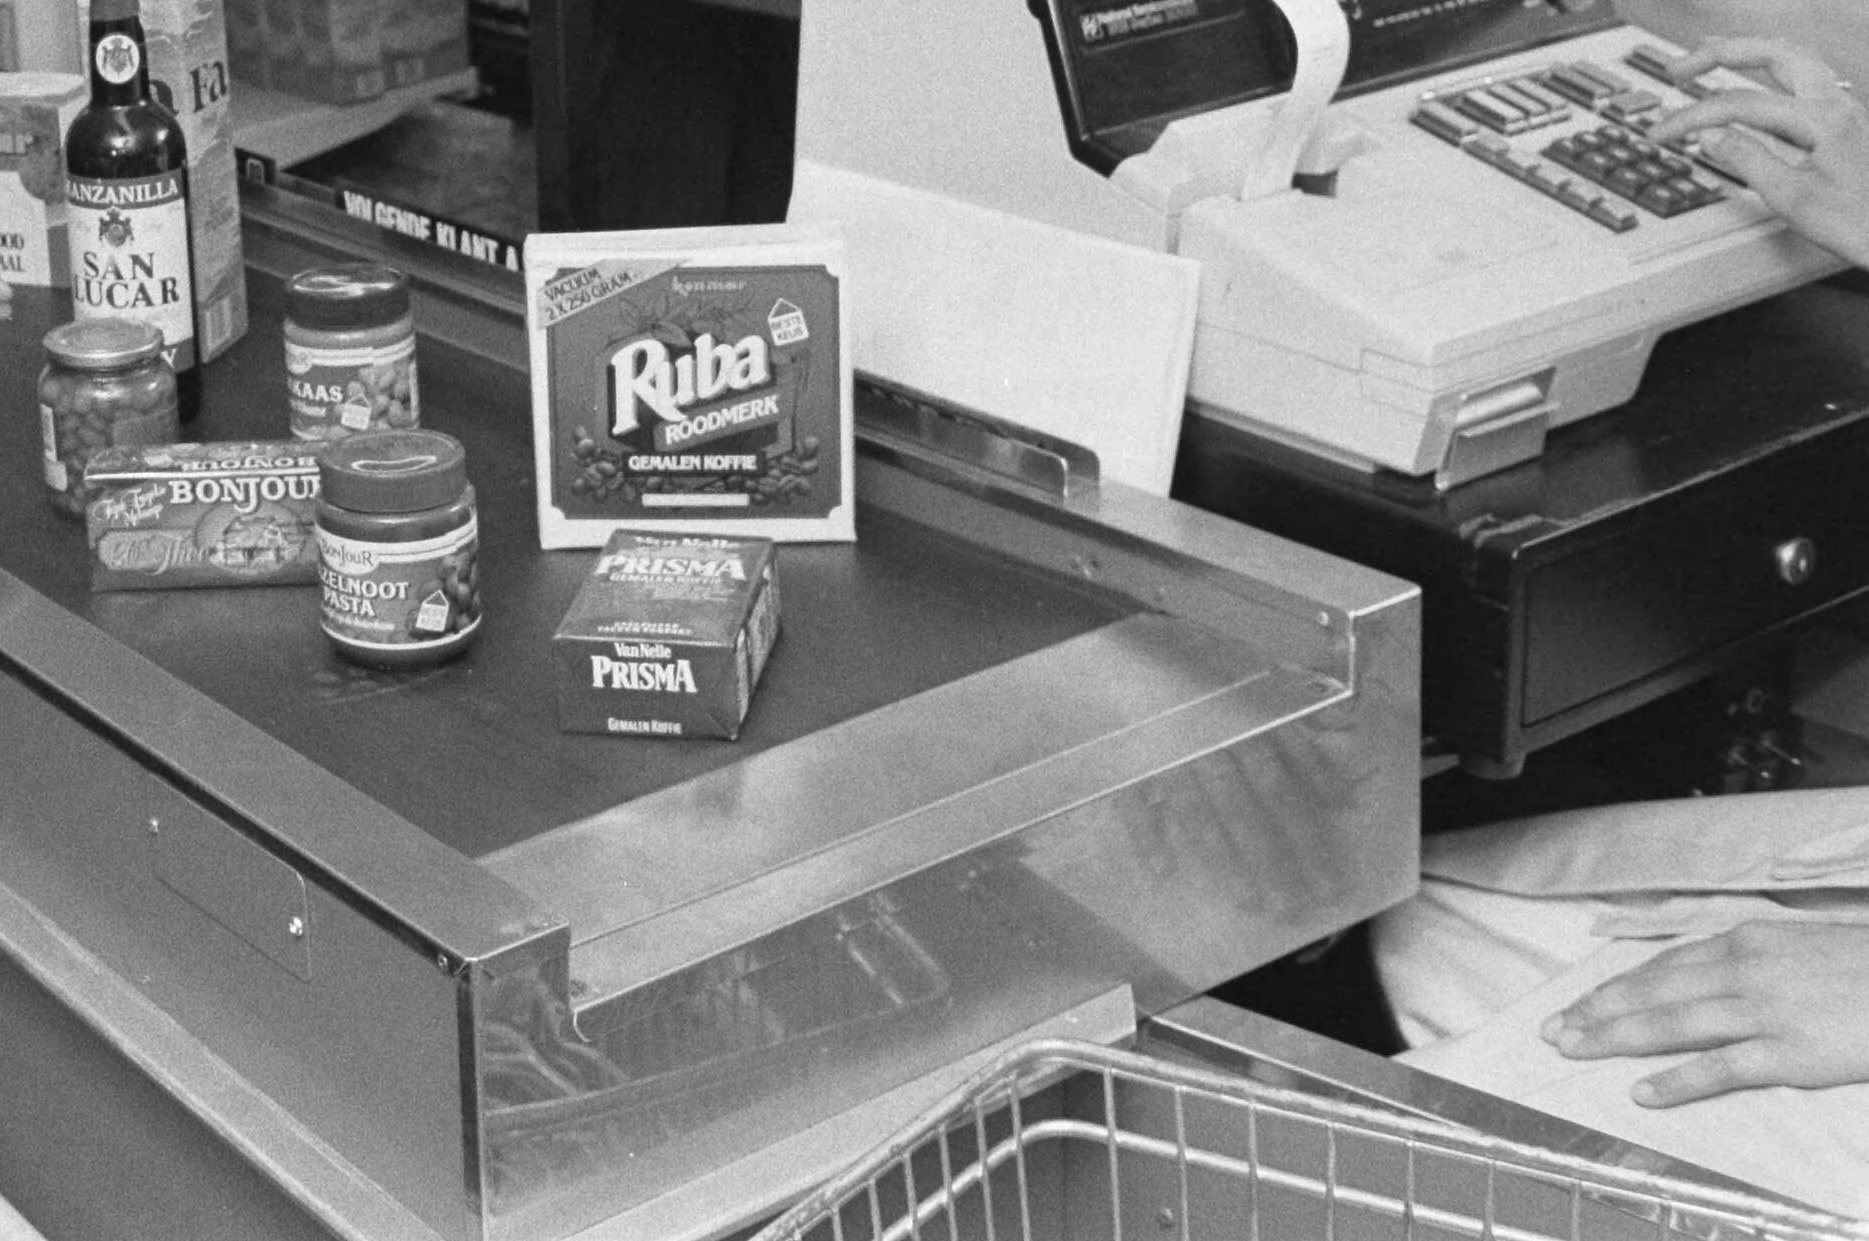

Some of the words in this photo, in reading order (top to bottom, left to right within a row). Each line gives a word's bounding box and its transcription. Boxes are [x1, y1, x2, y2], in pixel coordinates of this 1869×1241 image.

[190, 61, 226, 113] Fa
[83, 251, 155, 281] SAN
[75, 275, 180, 309] LUCAR
[544, 267, 602, 301] VACUUM
[610, 333, 771, 435] Ruba
[665, 394, 780, 446] ROODMERK
[628, 455, 701, 471] GEMALEN
[704, 455, 758, 471] KOFFIE
[320, 567, 409, 600] ZELNOOT
[593, 554, 747, 581] PRISMA
[323, 585, 376, 617] PASTA
[614, 642, 639, 657] Van
[640, 644, 672, 659] Nelle
[590, 655, 698, 694] PRISMA
